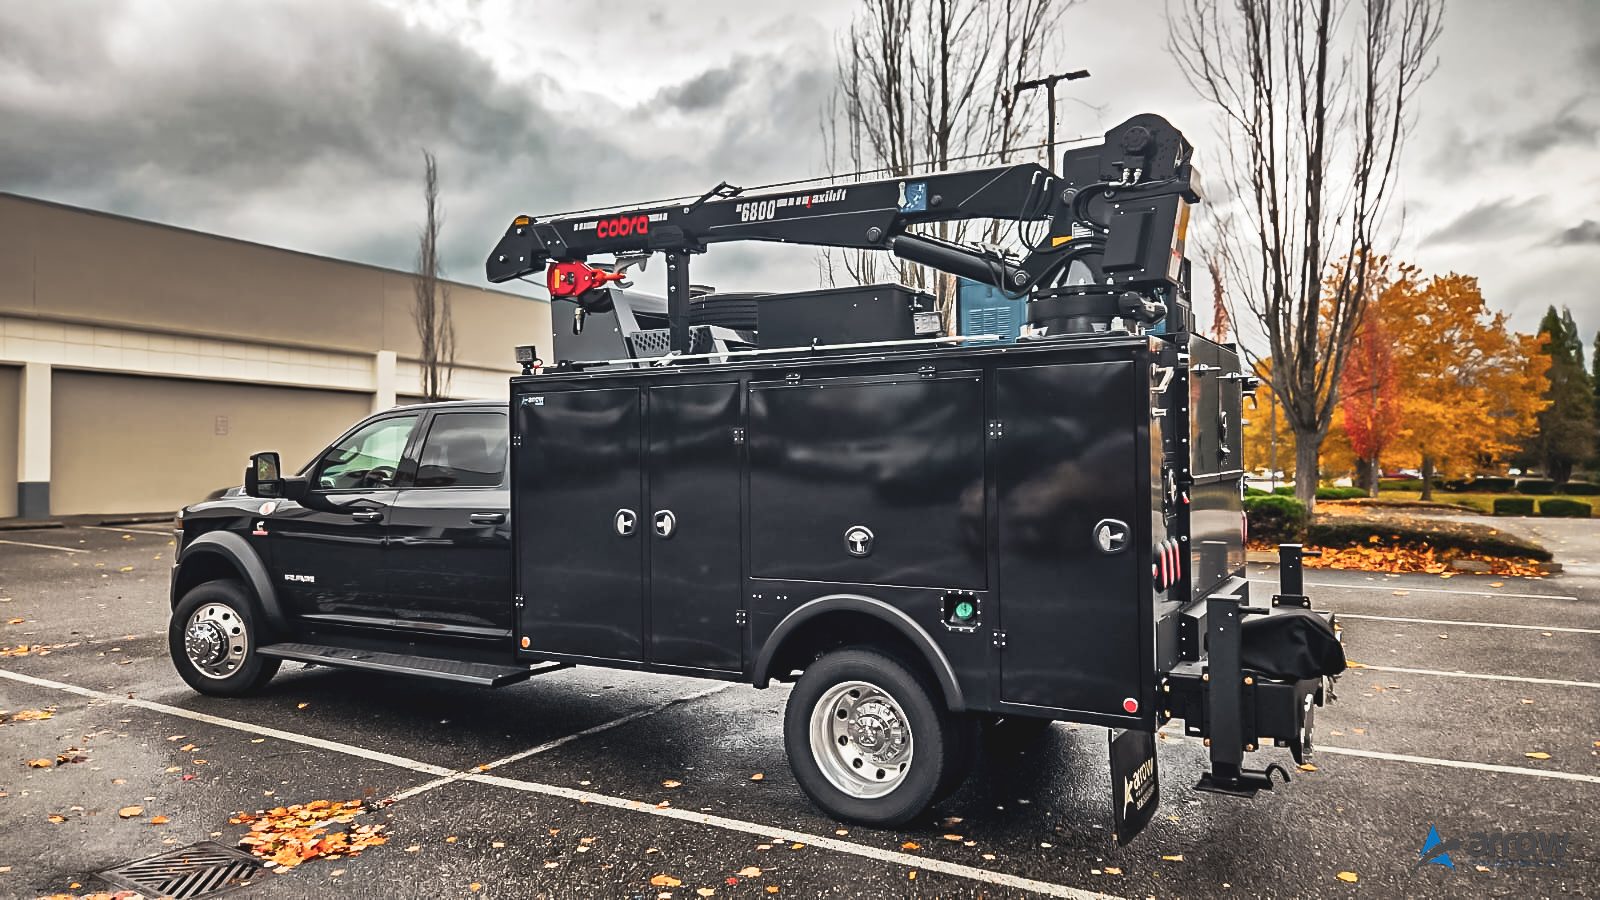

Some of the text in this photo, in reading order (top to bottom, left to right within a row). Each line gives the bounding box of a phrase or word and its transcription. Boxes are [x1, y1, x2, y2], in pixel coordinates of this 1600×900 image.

[741, 200, 776, 222] 6800
[597, 215, 649, 238] cobra
[1133, 757, 1154, 790] arrow
